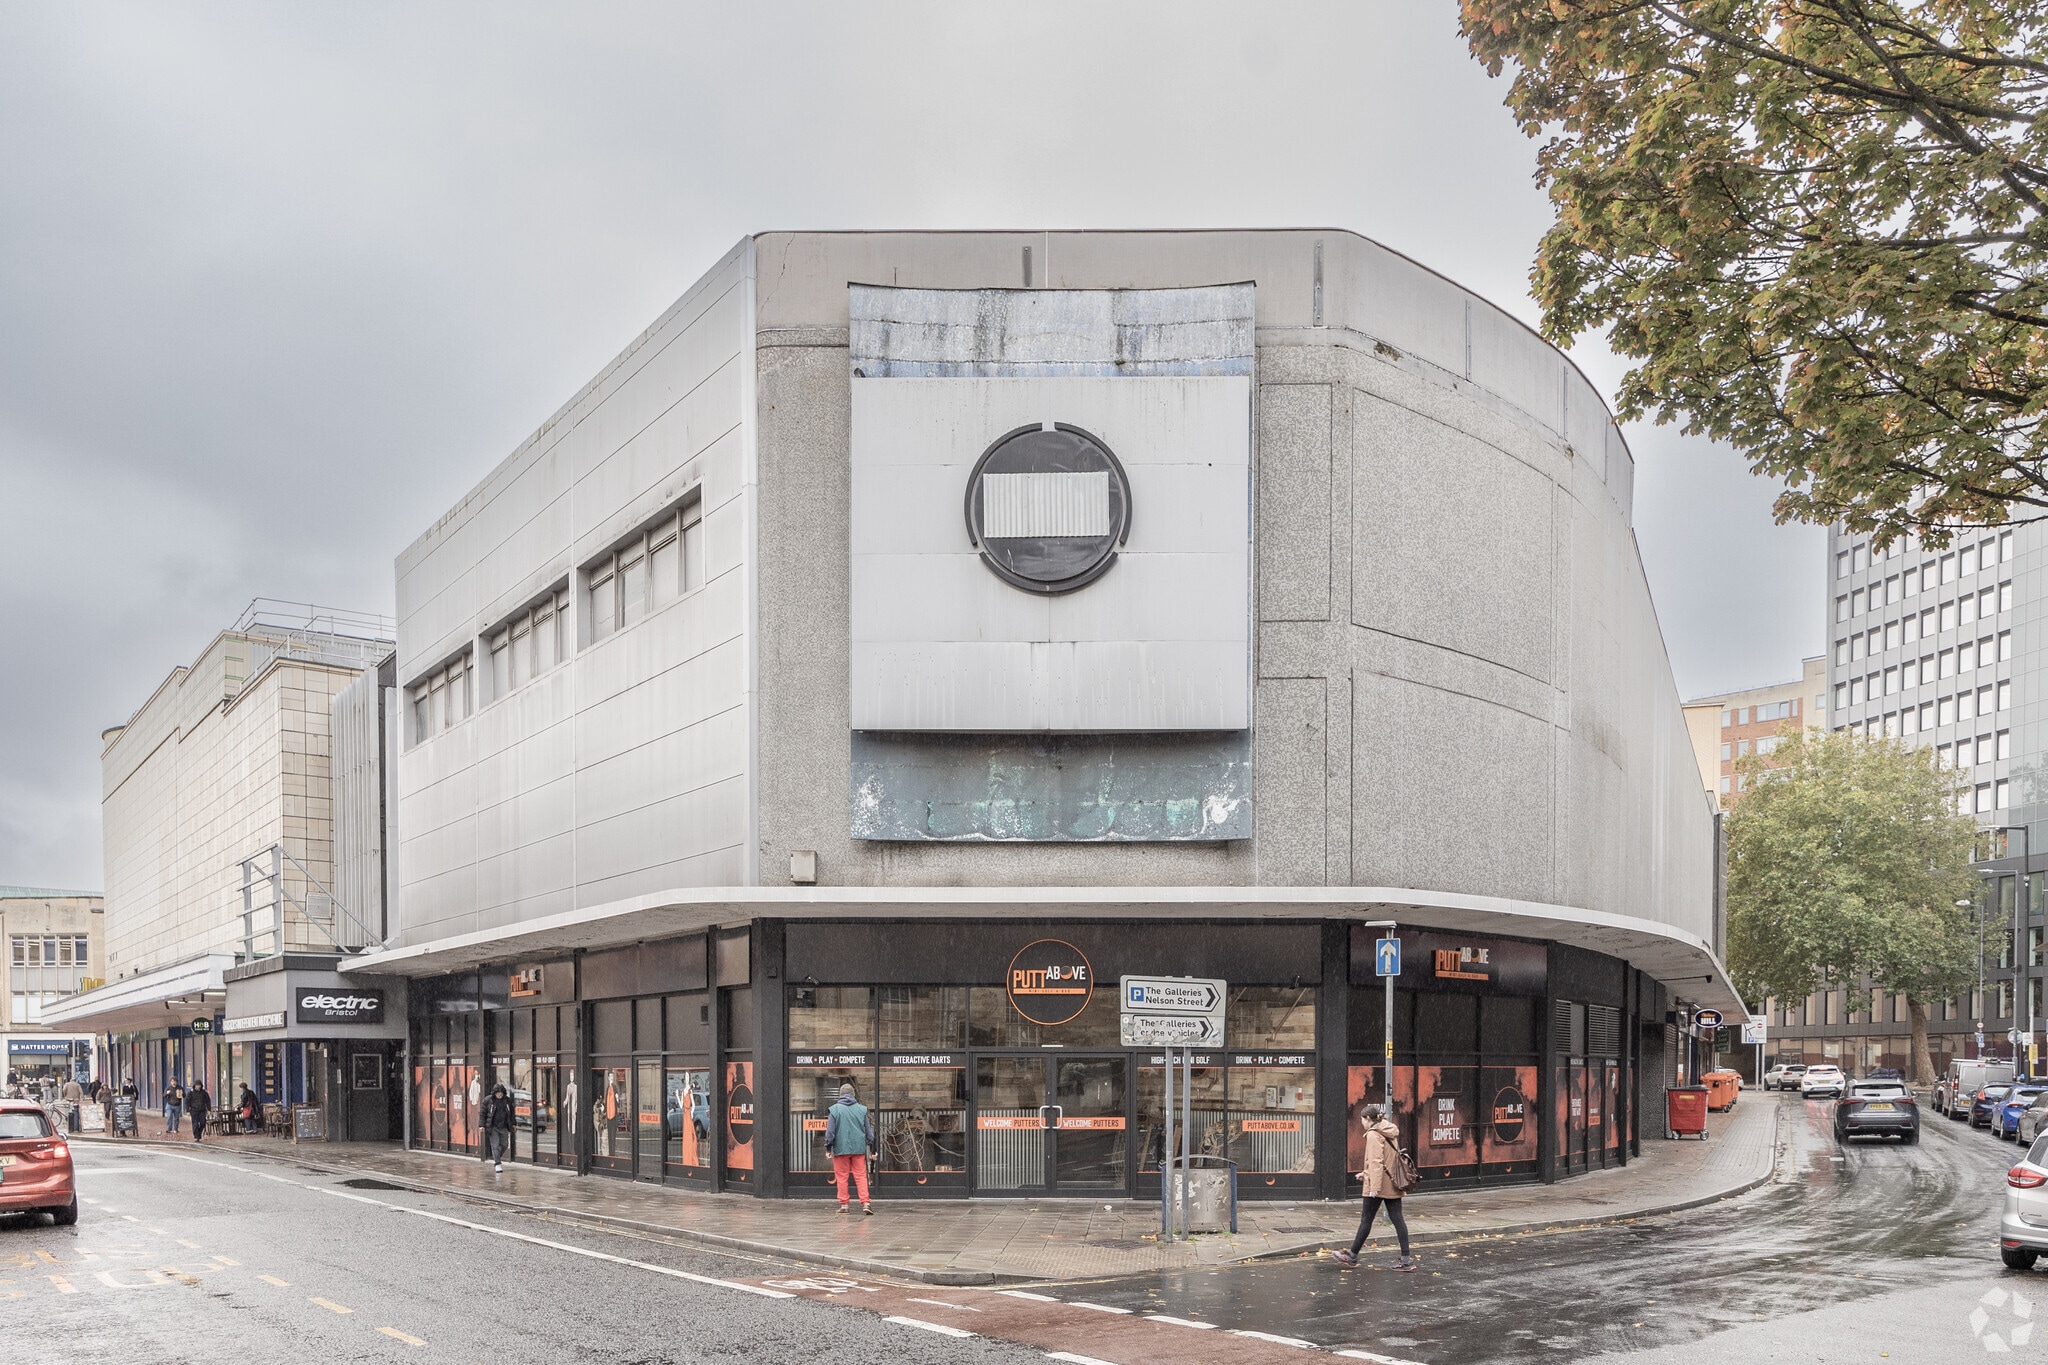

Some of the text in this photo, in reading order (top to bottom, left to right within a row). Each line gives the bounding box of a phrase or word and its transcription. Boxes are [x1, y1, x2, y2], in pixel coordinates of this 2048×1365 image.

[1133, 989, 1142, 1000] P
[1146, 986, 1202, 997] The Galleries
[302, 995, 379, 1010] electric
[1146, 996, 1204, 1006] Nelson Street
[1140, 1019, 1155, 1027] The
[797, 1056, 865, 1064] DRINK PLAY COMPETE
[893, 1056, 951, 1064] INTERACTIVE DARTS
[1151, 1056, 1181, 1064] HIGH-CH
[1196, 1056, 1210, 1064] GOLF
[1236, 1056, 1305, 1064] DRINK PLAY COMPETE
[1438, 1099, 1455, 1111] DRINK
[1439, 1113, 1454, 1125] PLAY
[1063, 1120, 1092, 1128] WELCOME
[1247, 1122, 1296, 1130] PUTTABOVE.CO.UK
[1432, 1128, 1460, 1141] COMPETE
